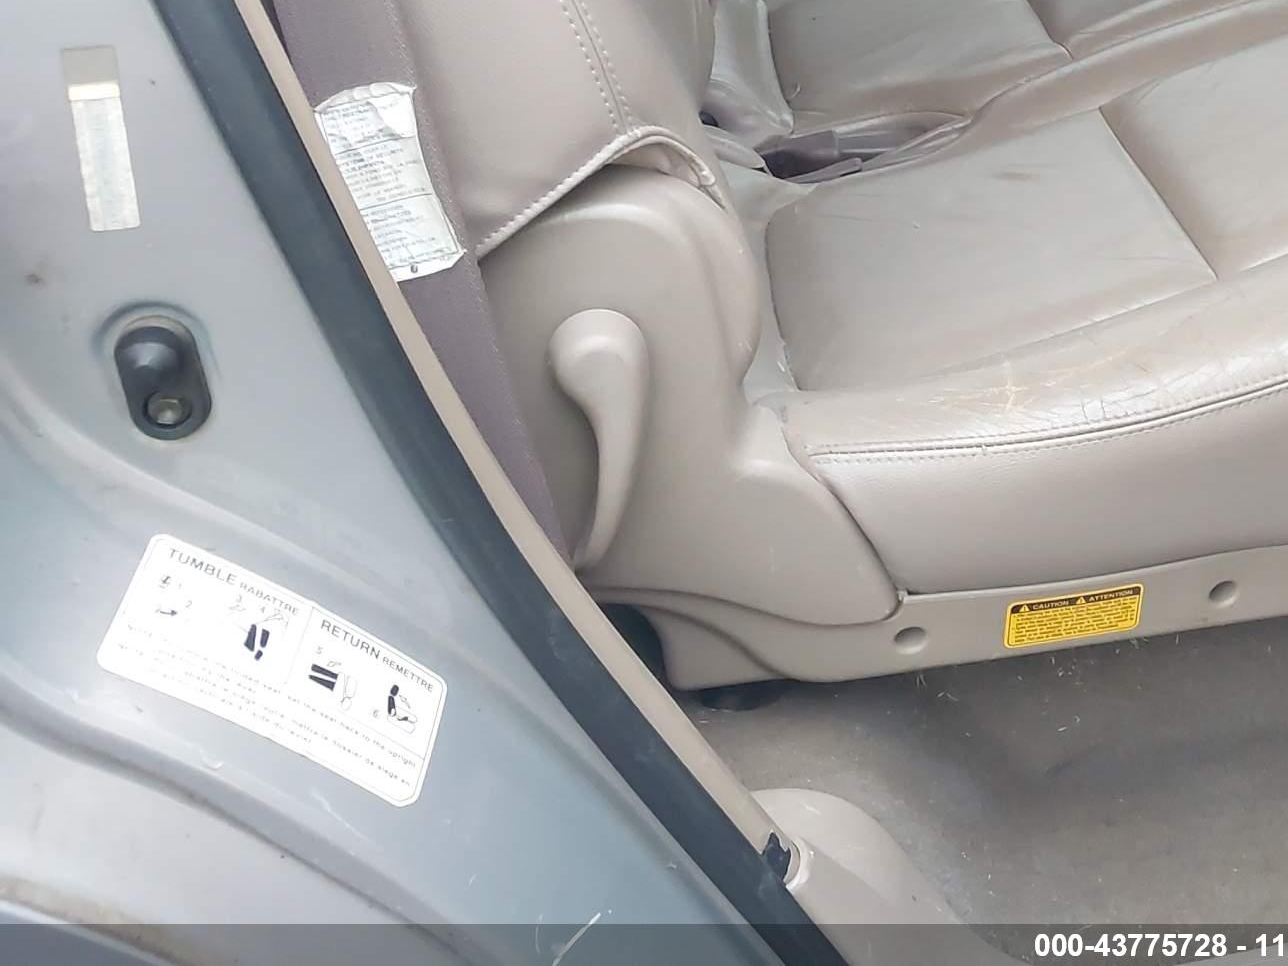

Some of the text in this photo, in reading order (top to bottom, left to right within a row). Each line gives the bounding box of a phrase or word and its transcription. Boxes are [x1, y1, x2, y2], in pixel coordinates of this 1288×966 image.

[169, 547, 300, 616] TUMBLE RABATTRE
[1032, 589, 1134, 610] CAUTION ATTENTION
[316, 645, 324, 654] 5
[321, 619, 434, 693] RETURN REMETTRE
